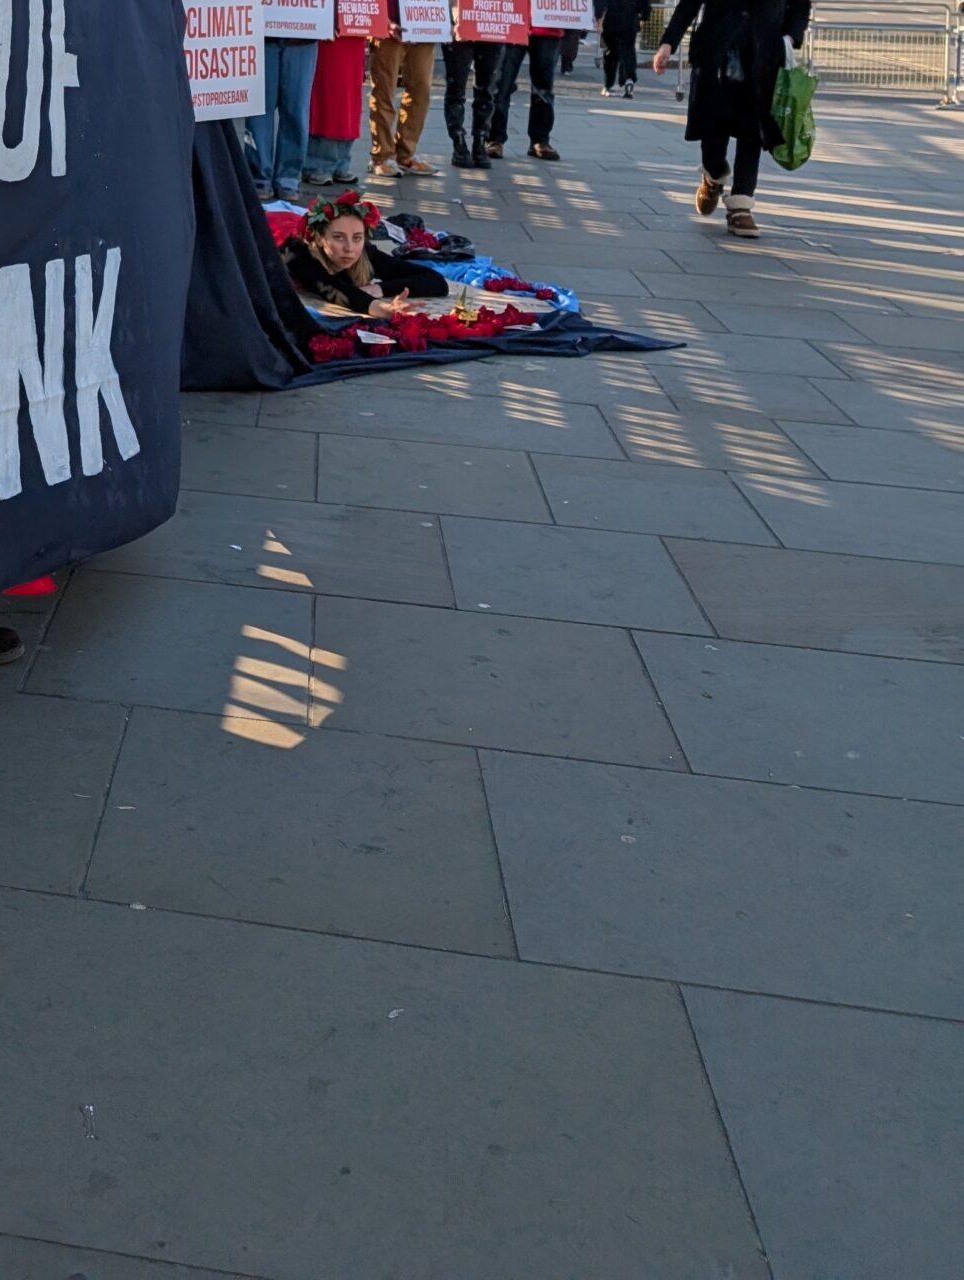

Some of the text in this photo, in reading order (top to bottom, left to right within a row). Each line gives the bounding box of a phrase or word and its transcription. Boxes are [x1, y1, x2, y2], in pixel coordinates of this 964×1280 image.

[338, 2, 379, 15] ENEWABLES
[473, 0, 513, 12] PROFIT ON
[344, 15, 372, 26] UP 29%
[405, 6, 446, 22] WORKERS
[462, 10, 524, 25] INTERNATIONAL
[186, 6, 253, 38] CLIMATE
[265, 21, 317, 31] #STOPROSEBANK
[477, 22, 510, 34] MARKET
[184, 46, 256, 80] DISASTER
[193, 90, 249, 107] #STOPROSEBANK
